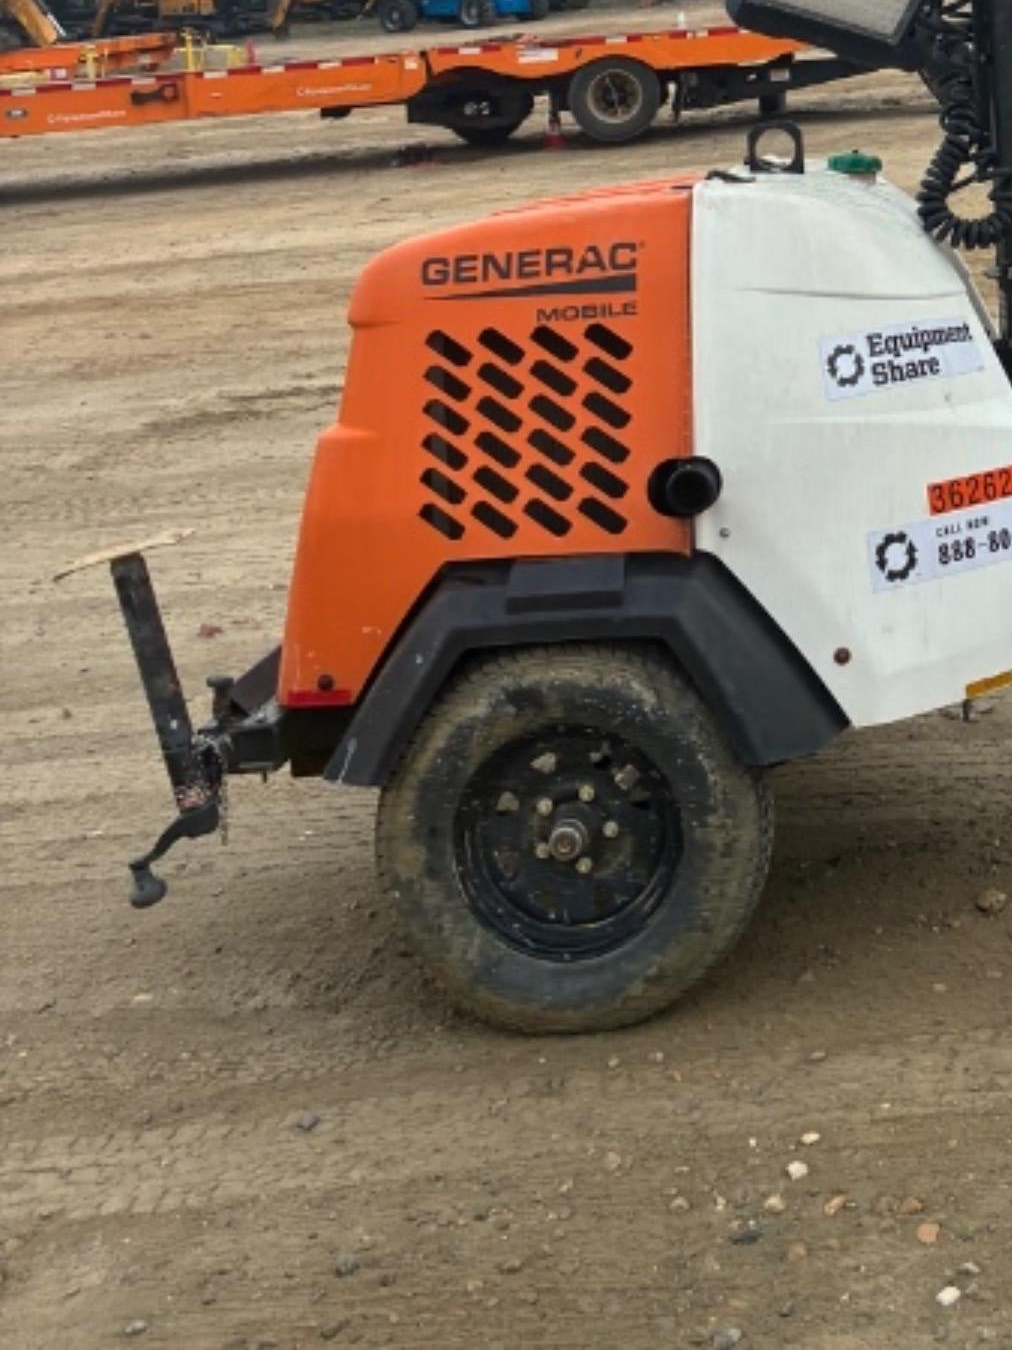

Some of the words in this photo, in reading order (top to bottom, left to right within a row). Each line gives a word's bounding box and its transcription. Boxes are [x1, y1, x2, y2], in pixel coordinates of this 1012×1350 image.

[420, 242, 638, 286] GENERAC
[536, 301, 638, 323] MOBILE
[866, 322, 973, 357] Equipment
[871, 356, 940, 387] Share
